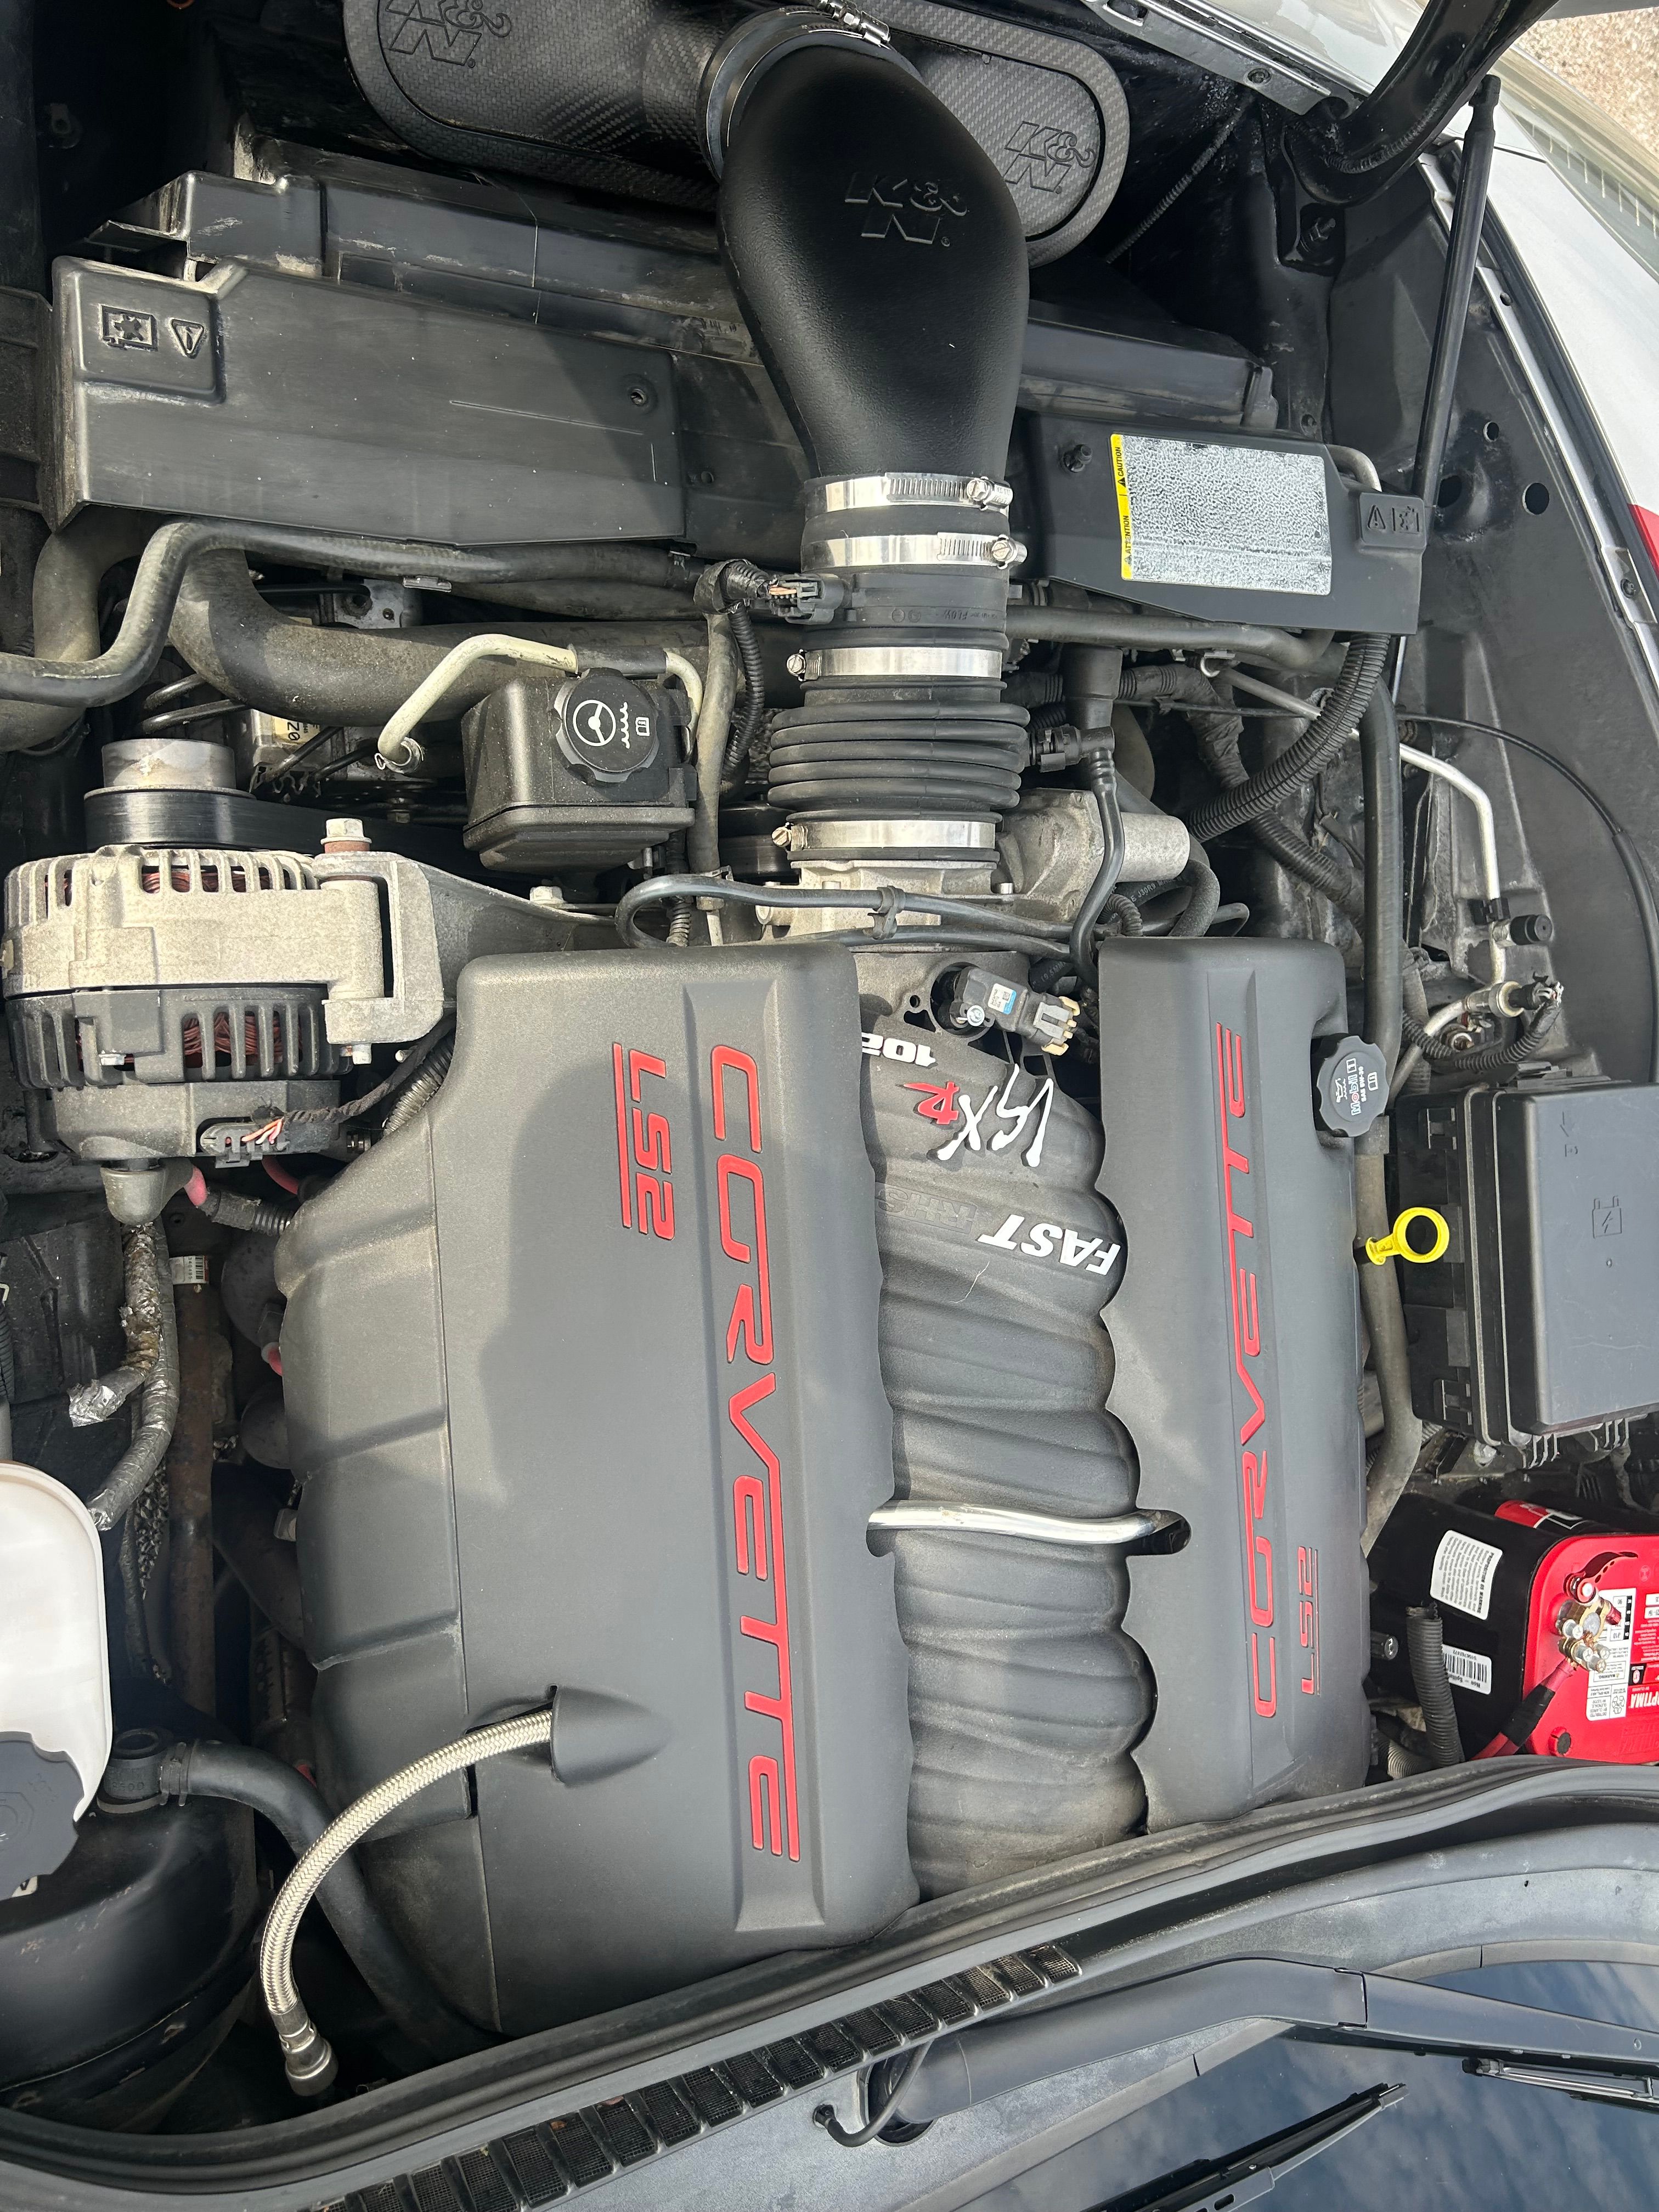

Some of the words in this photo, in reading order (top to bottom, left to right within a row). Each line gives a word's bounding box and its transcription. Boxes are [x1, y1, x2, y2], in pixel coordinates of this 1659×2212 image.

[1115, 446, 1124, 477] CAUTION
[1123, 515, 1132, 554] ATTENTION
[944, 610, 969, 620] FLOW
[1138, 883, 1156, 898] J30R9
[1347, 1074, 1361, 1116] Mobil
[629, 1048, 675, 1241] LS2
[978, 1214, 1121, 1276] FAST
[1216, 1022, 1277, 1718] CORVETTE
[712, 1045, 799, 1862] CORVETTE
[1297, 1545, 1316, 1695] LS2
